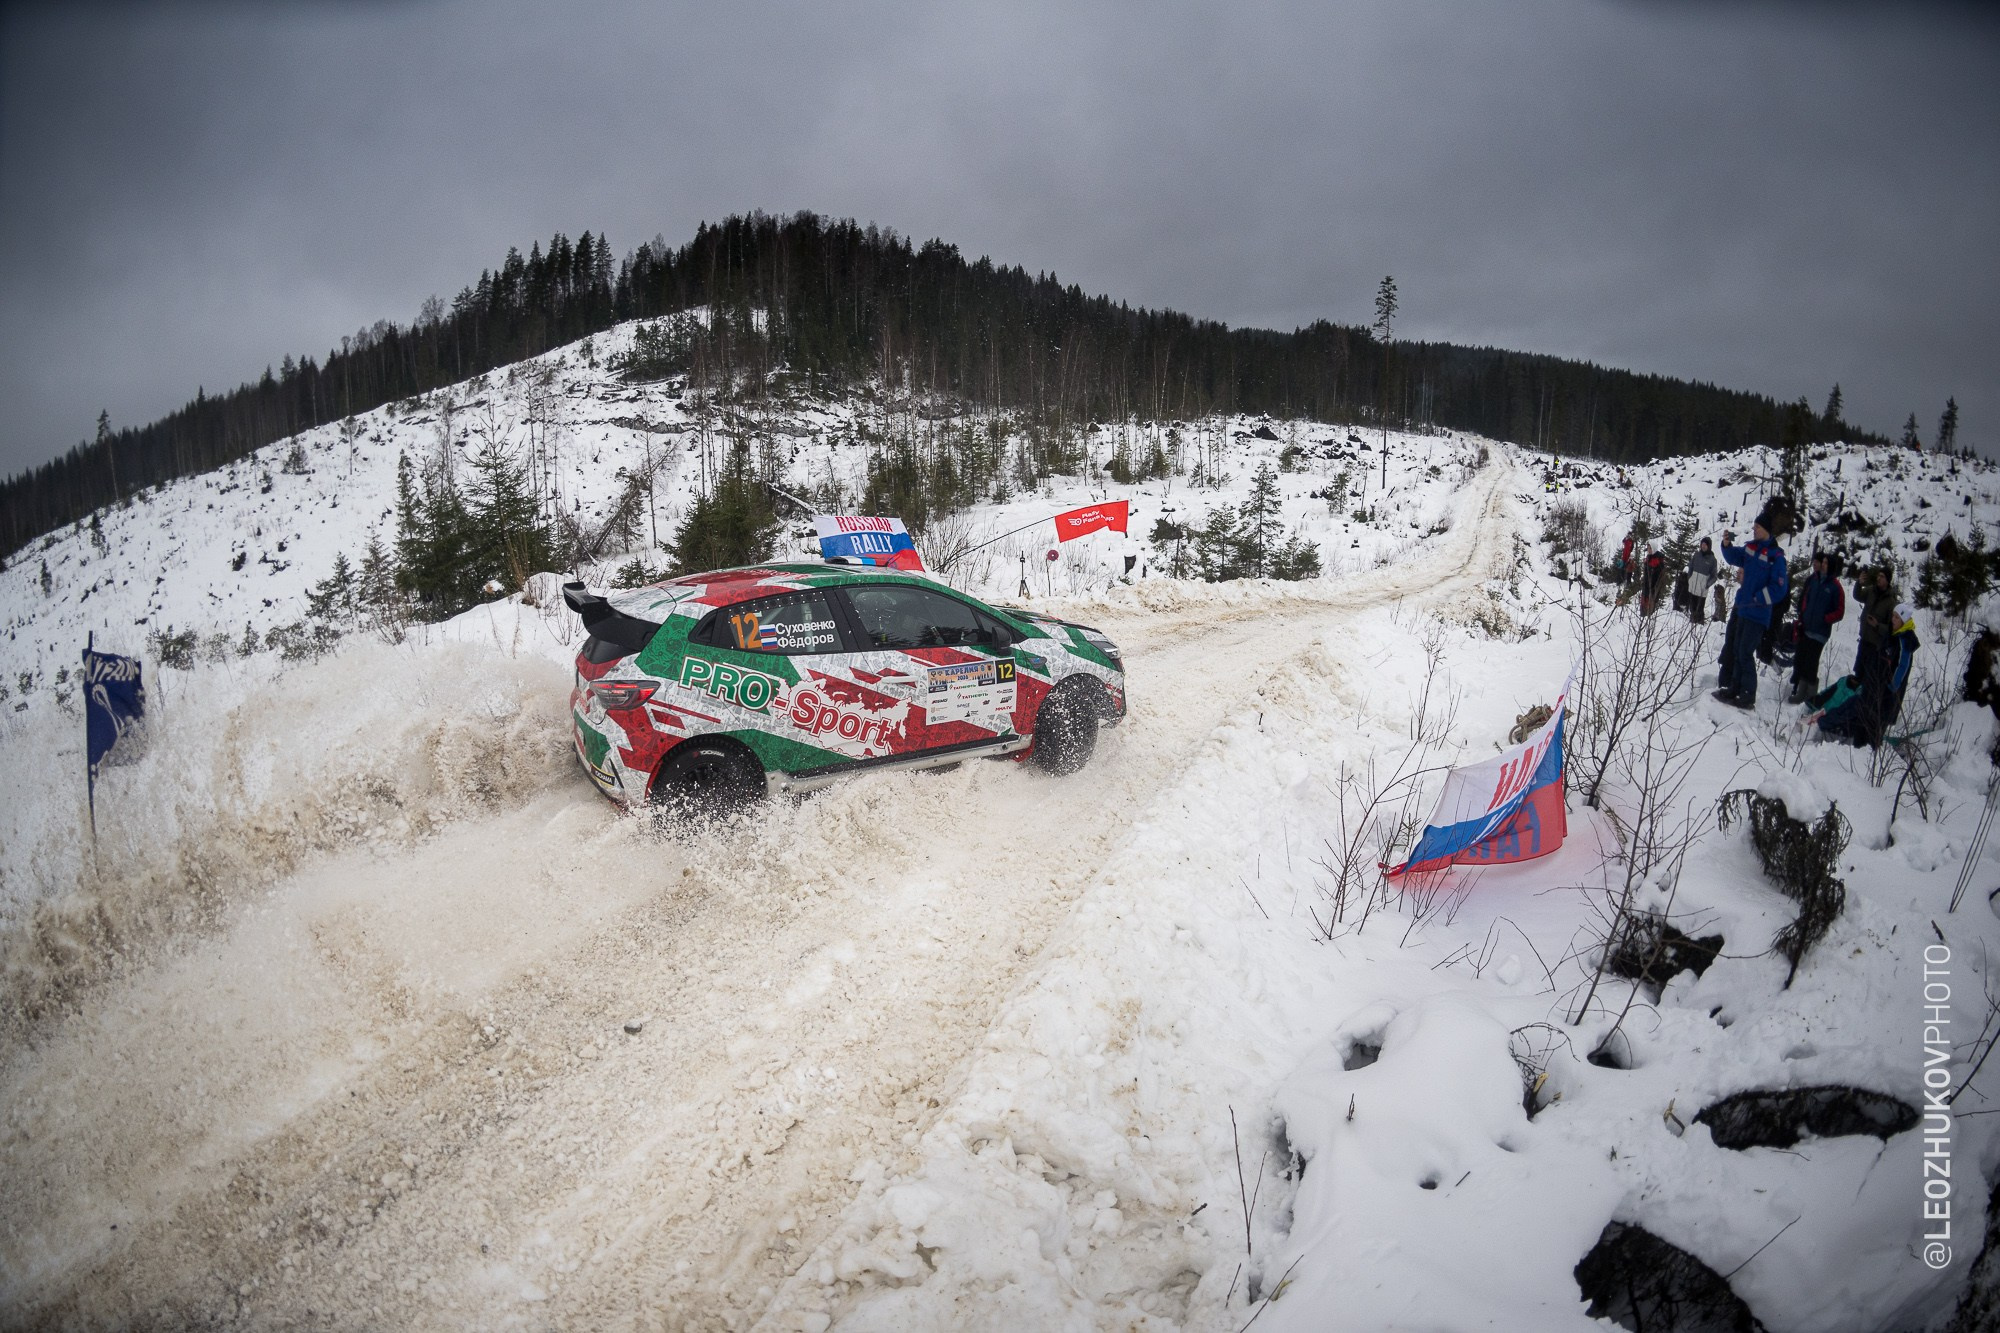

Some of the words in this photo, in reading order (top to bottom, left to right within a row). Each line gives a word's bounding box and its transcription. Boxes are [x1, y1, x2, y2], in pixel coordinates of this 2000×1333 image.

[835, 516, 893, 532] RUSSIAN
[850, 534, 893, 554] RALLY
[731, 612, 762, 649] 12
[775, 620, 836, 637] Суховенко
[777, 634, 835, 649] Фёдоров
[944, 665, 979, 676] КАРЕЛИЯ
[998, 663, 1014, 679] 12
[962, 692, 989, 700] ТАТНЕФТЬ
